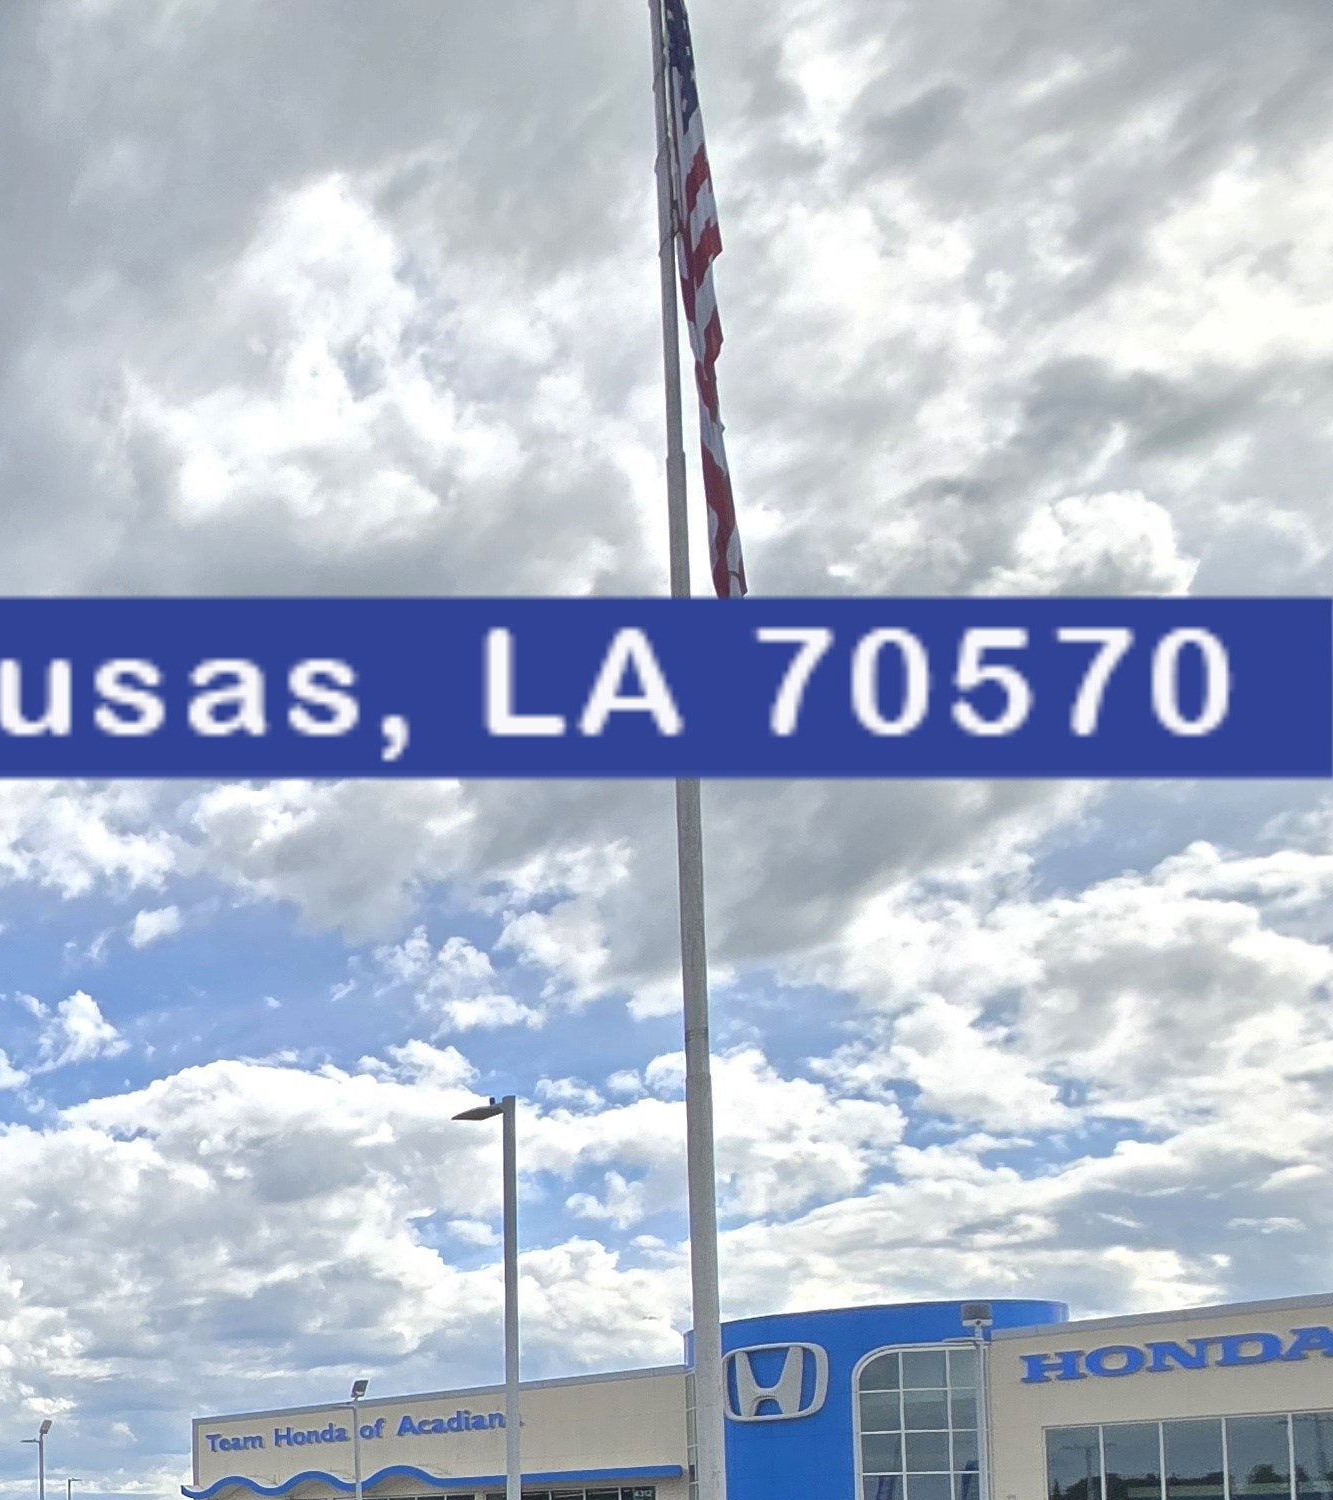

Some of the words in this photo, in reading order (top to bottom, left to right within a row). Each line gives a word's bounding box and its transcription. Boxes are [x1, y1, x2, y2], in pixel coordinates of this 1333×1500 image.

[1020, 1326, 1333, 1383] HONDA
[206, 1433, 264, 1453] Team
[274, 1423, 351, 1447] Honda
[359, 1418, 387, 1440] of
[396, 1409, 524, 1436] Acadian
